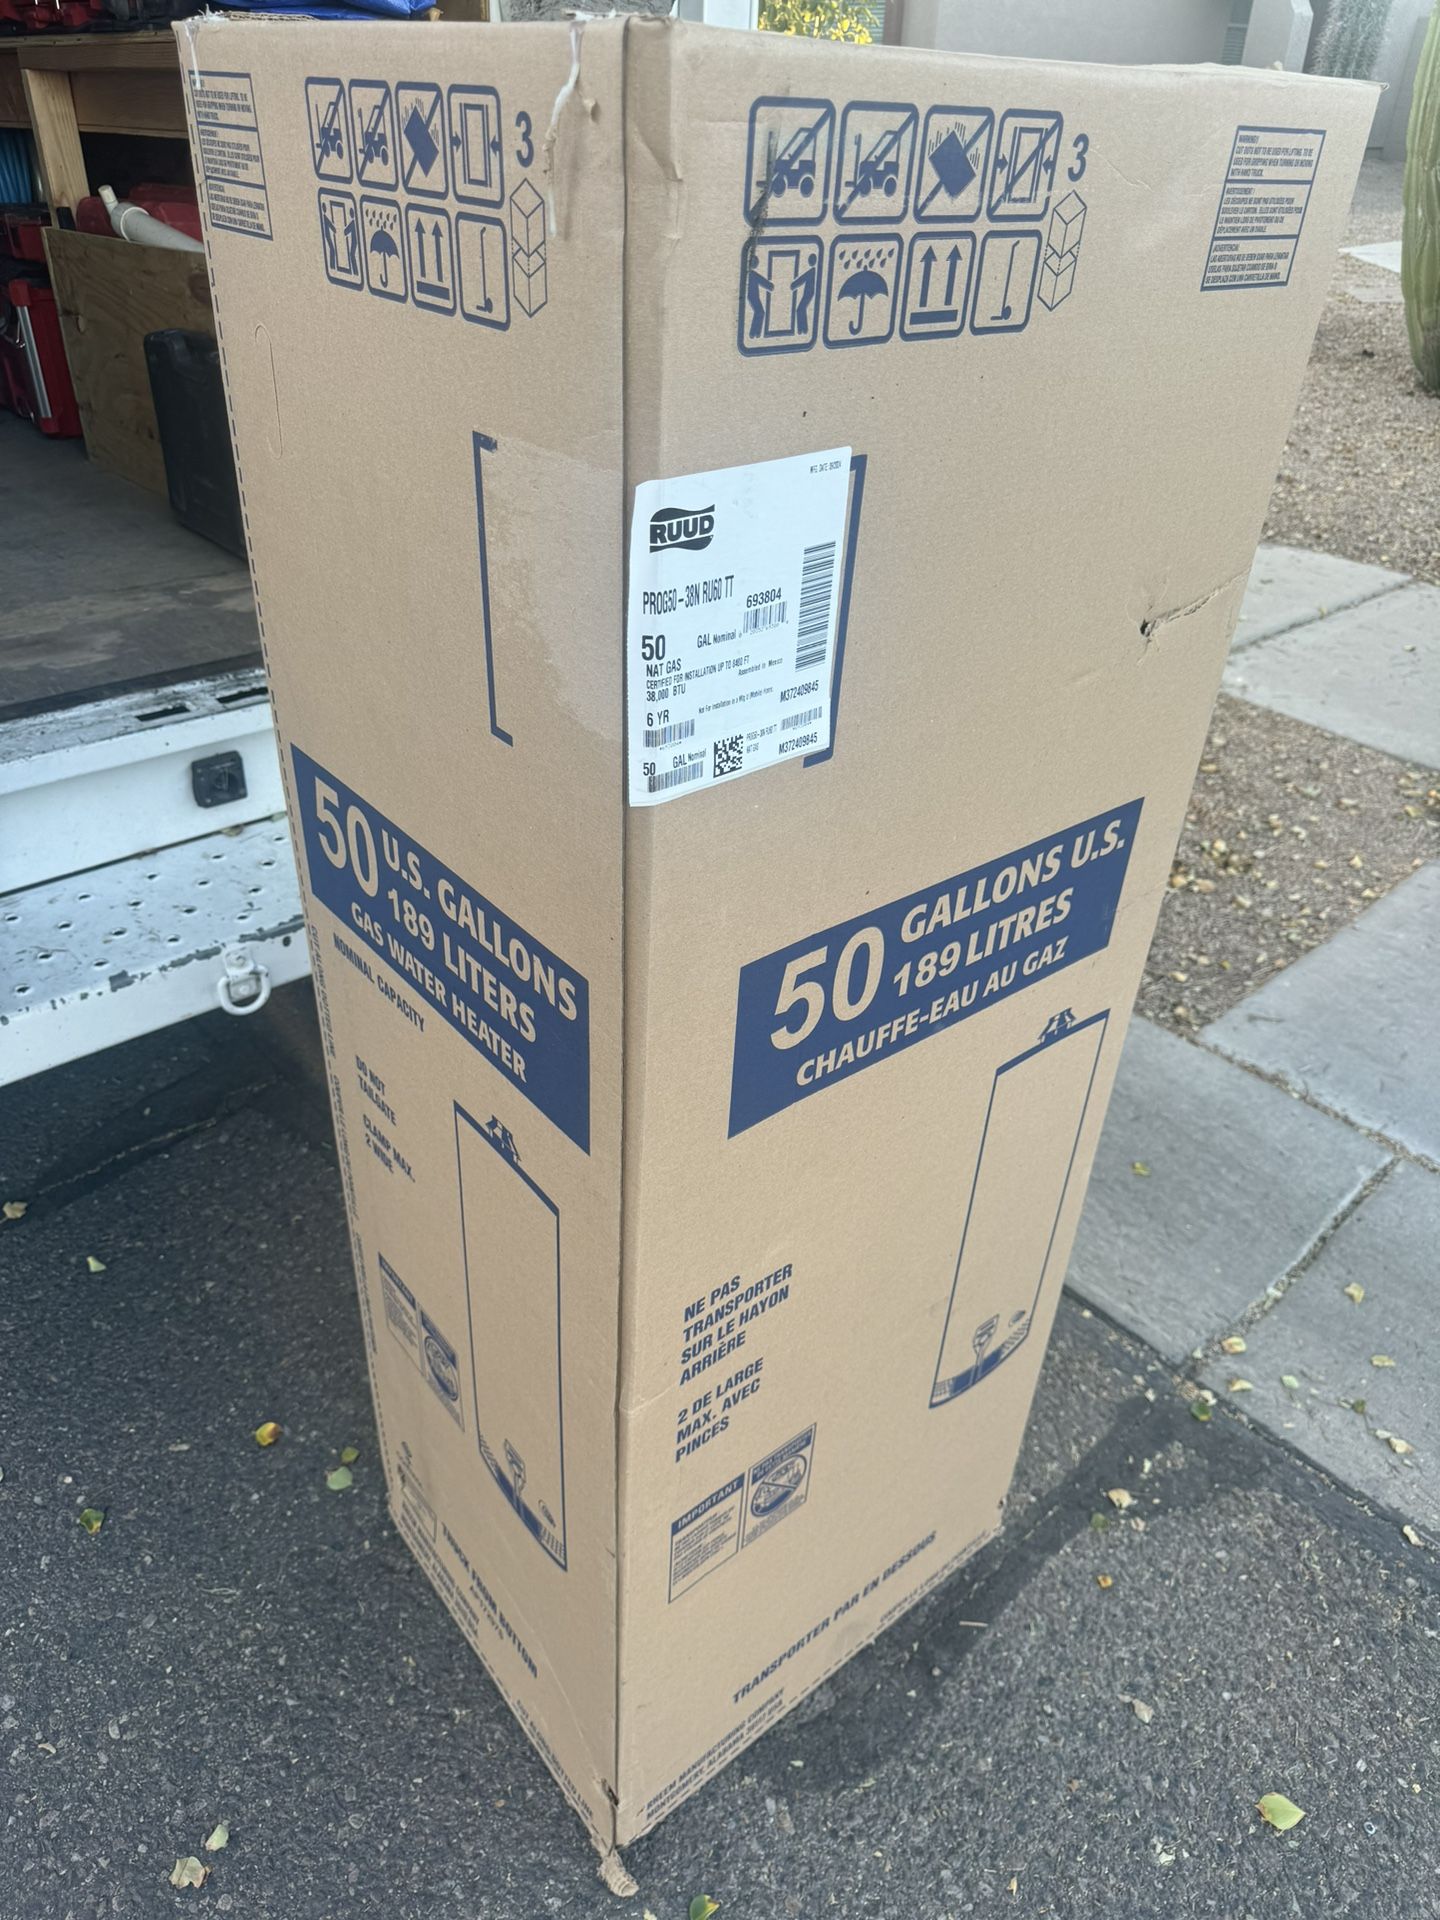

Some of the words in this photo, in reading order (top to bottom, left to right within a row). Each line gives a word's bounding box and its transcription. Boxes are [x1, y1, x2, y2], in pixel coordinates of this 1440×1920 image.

[515, 111, 534, 168] 3
[1067, 133, 1089, 182] 3
[650, 514, 715, 544] RUUD
[702, 578, 722, 603] RU60
[725, 575, 734, 598] TT
[746, 588, 782, 608] 693804
[641, 635, 666, 661] 50
[697, 633, 711, 648] GAL
[713, 630, 737, 645] Nominal
[646, 663, 664, 677] NAT
[666, 658, 682, 674] GAS
[646, 676, 672, 690] CERTIFIED
[673, 673, 683, 684] FOR
[685, 664, 716, 681] INSTALLATION
[717, 662, 724, 672] UP
[646, 688, 669, 702] 38,000
[672, 683, 686, 696] BTU
[647, 712, 654, 727] 6
[657, 709, 670, 724] YR
[643, 763, 656, 777] 50
[673, 755, 687, 769] GAL
[314, 776, 379, 897] 50
[382, 828, 430, 900] U.S.
[437, 878, 578, 1022] GALLONS
[770, 926, 885, 1051] 50
[901, 845, 1063, 943] GALLONS
[1070, 819, 1125, 868] U.S.
[893, 941, 961, 996] 189
[965, 887, 1074, 966] LITRES
[333, 932, 375, 984] NOMINAL
[376, 973, 424, 1032] CAPACITY
[388, 888, 434, 951] 189
[444, 932, 536, 1042] LITERS
[351, 902, 383, 946] GAS
[388, 937, 446, 1007] WATER
[453, 995, 527, 1082] HEATER
[796, 986, 976, 1086] CHAUFFE-EAU
[983, 966, 1015, 998] AU
[1023, 936, 1069, 976] GAZ
[355, 1054, 368, 1077] DO
[369, 1069, 386, 1096] NOT
[358, 1074, 396, 1126] TAILGATE
[363, 1114, 391, 1151] CLAMP
[683, 1264, 793, 1343] TRANSPORTER
[684, 1297, 705, 1322] NE
[710, 1275, 740, 1305] PAS
[681, 1334, 713, 1365] SUR
[717, 1319, 735, 1341] LE
[739, 1285, 789, 1326] HAYON
[680, 1331, 746, 1386] ARRIÈRE
[677, 1409, 717, 1445] MAX.
[722, 1378, 760, 1412] AVEC
[678, 1408, 688, 1425] 2
[692, 1391, 712, 1415] DE
[716, 1357, 764, 1399] LARGE
[675, 1416, 730, 1463] PINCES
[678, 1479, 740, 1529] IMPORTANT
[732, 1617, 830, 1704] TRANSPORTER
[833, 1593, 860, 1622] PAR
[862, 1576, 880, 1598] EN
